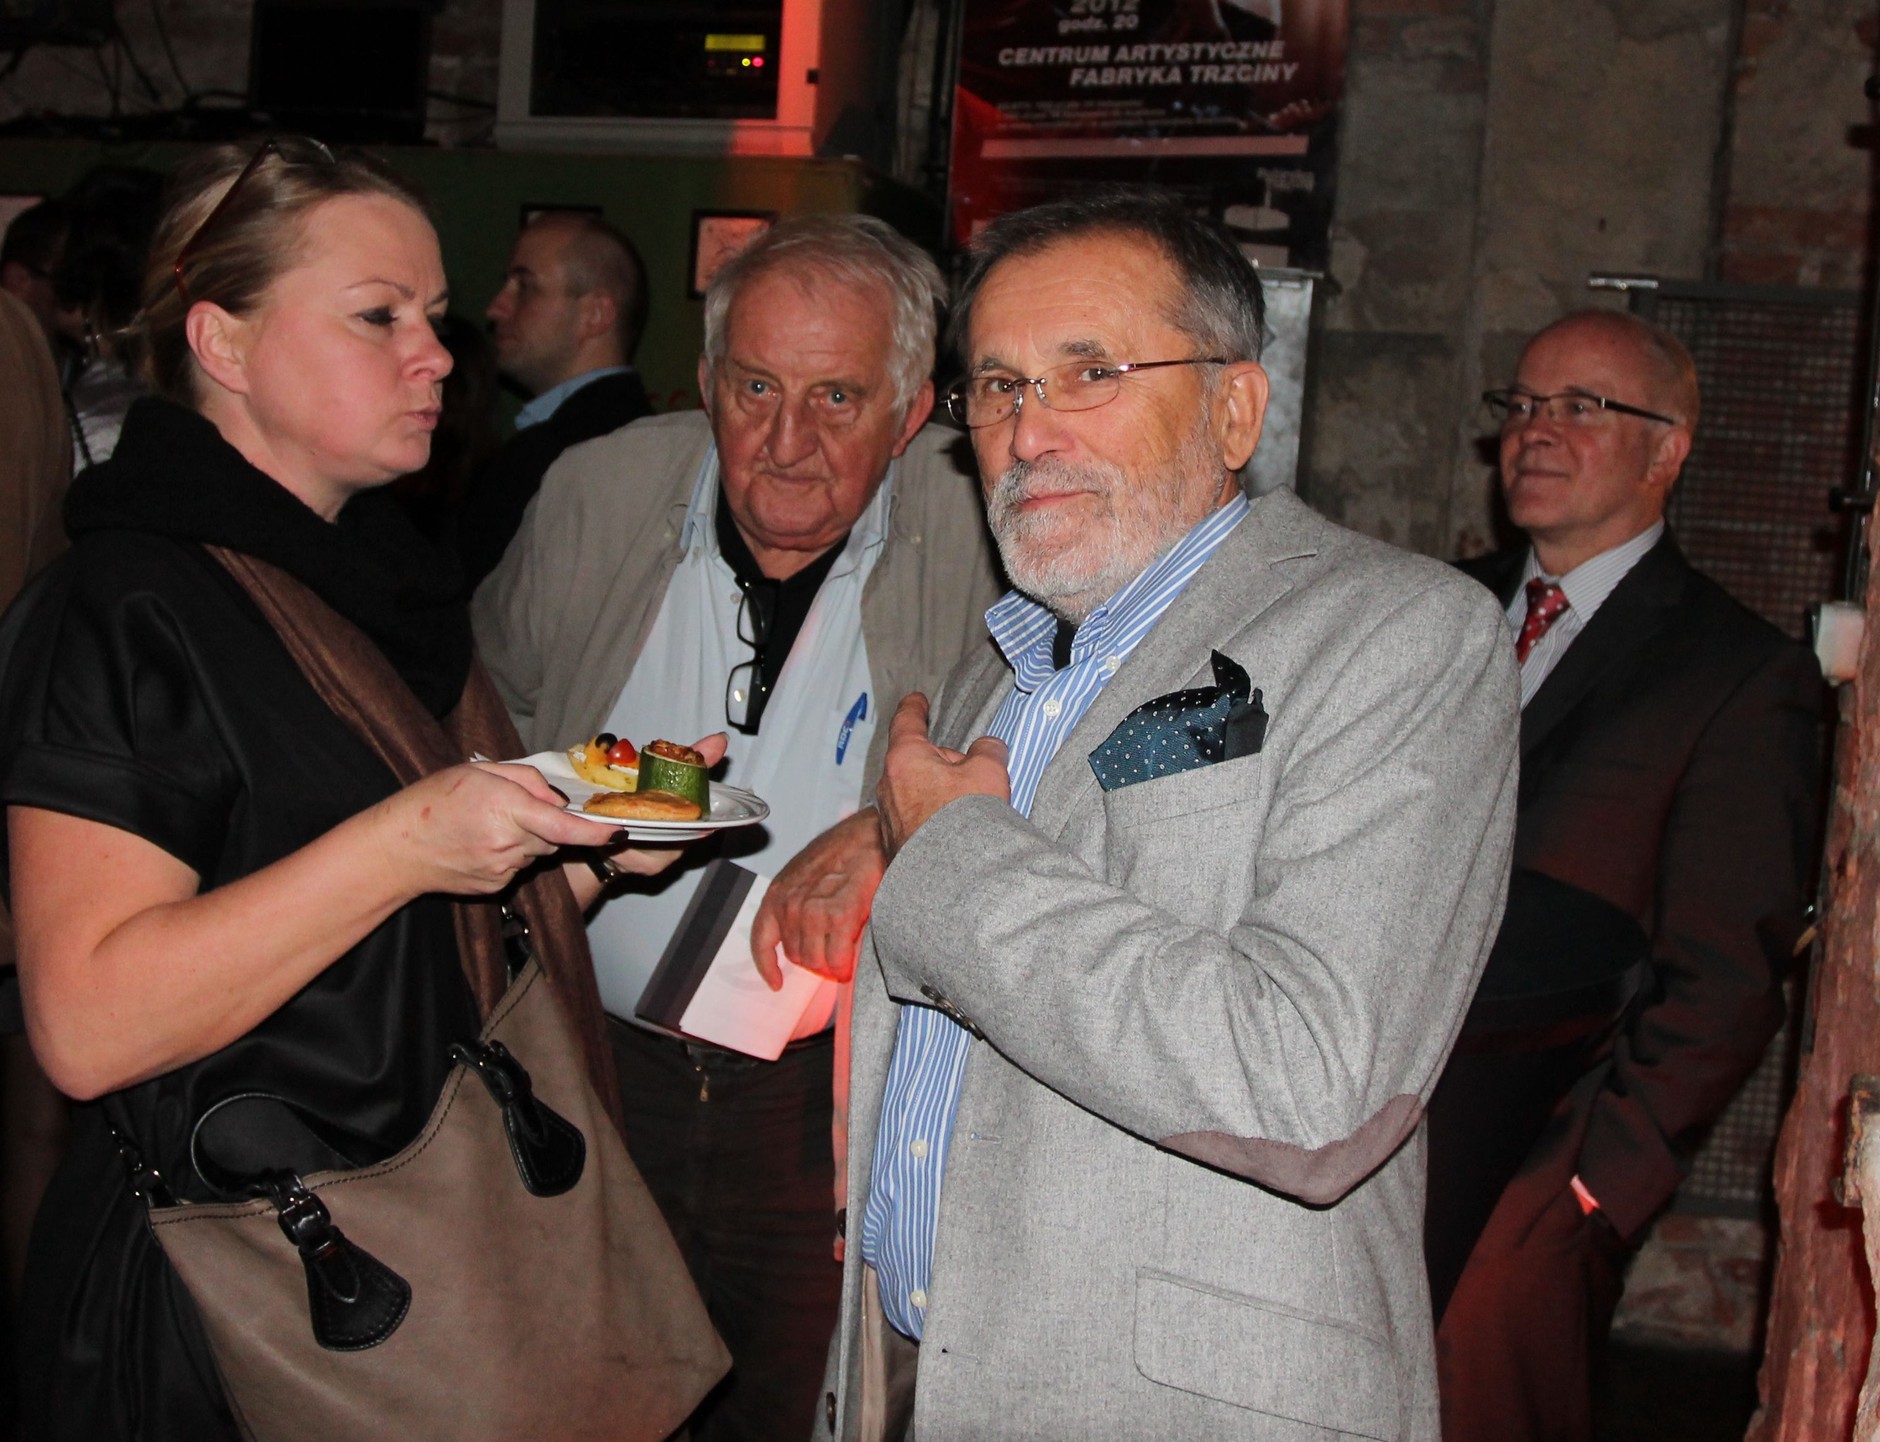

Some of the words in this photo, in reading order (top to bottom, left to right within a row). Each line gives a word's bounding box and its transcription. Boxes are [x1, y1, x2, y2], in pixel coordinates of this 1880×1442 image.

[1058, 16, 1107, 33] godz.
[1112, 14, 1139, 29] 20
[998, 47, 1110, 65] CENTRUM
[1115, 41, 1285, 61] ARTYSTYCZNE
[1071, 67, 1182, 85] FABRYKA
[1191, 63, 1298, 82] TRZCINY
